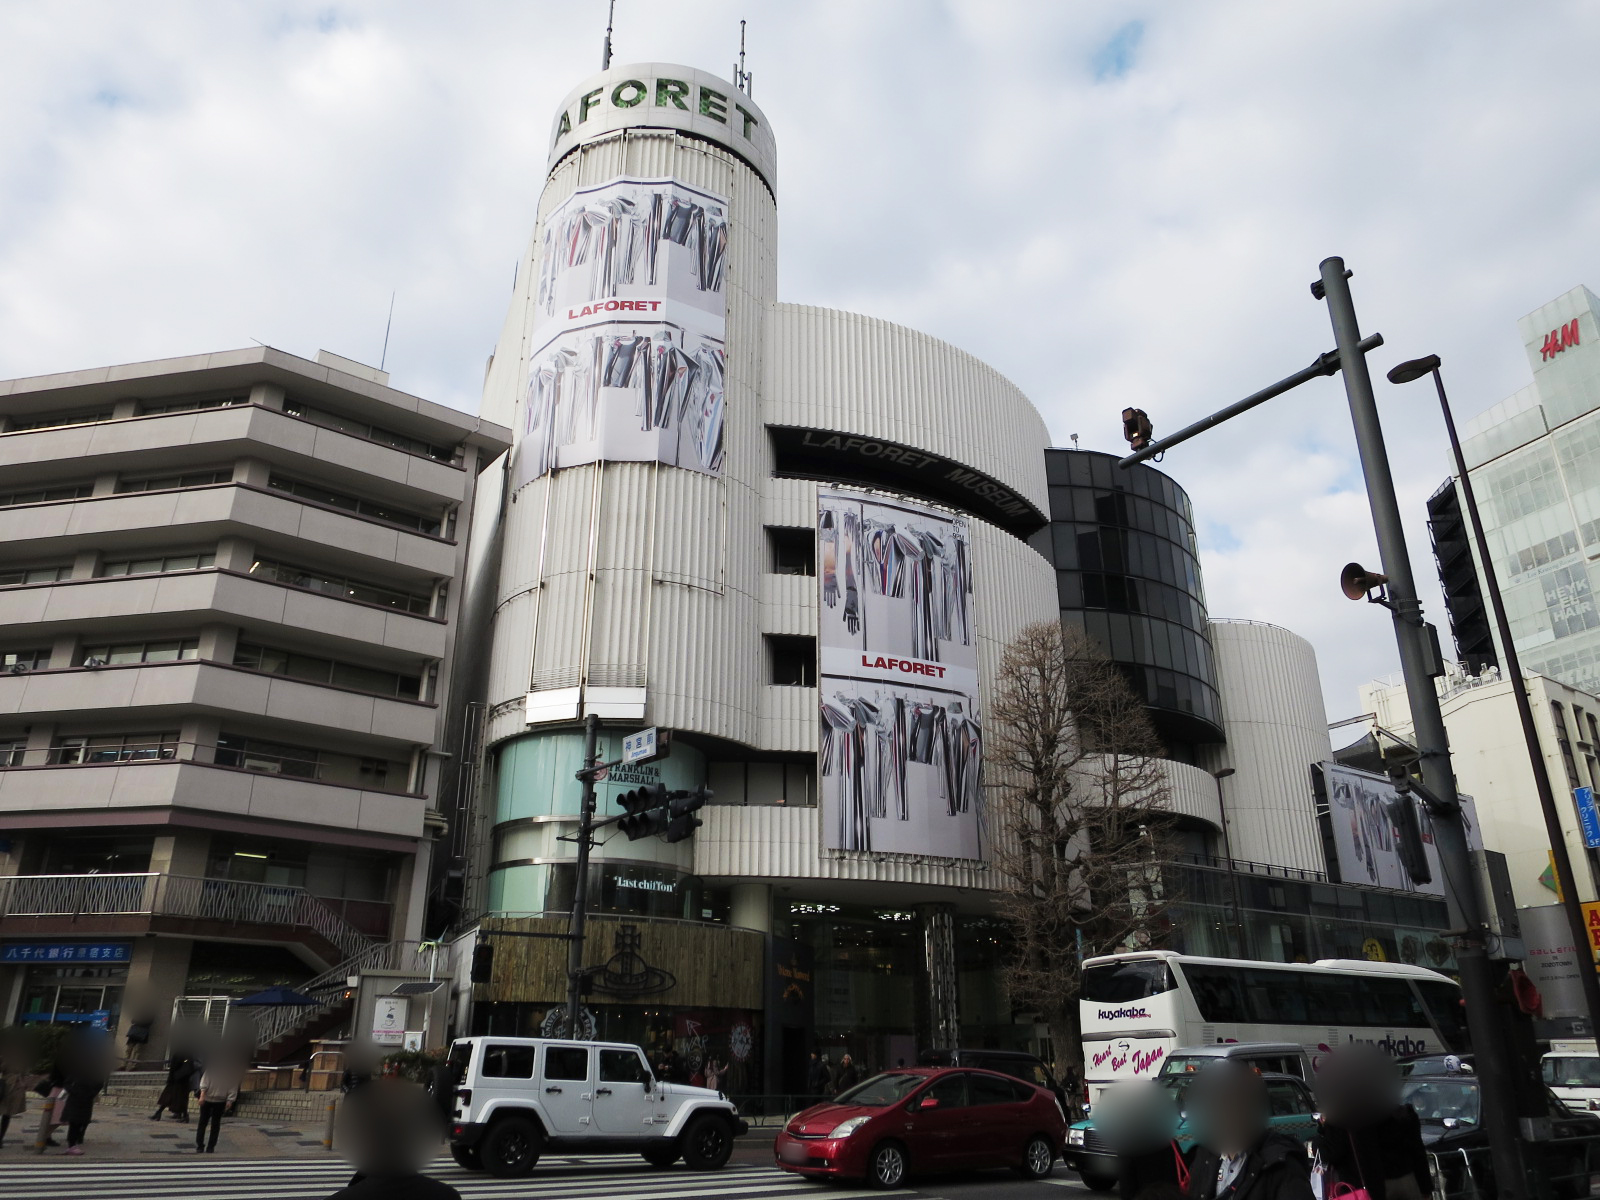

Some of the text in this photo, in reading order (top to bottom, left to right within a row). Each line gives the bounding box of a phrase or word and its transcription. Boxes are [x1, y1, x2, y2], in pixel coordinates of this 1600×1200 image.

[568, 300, 662, 320] LAFORET
[1540, 318, 1580, 362] H&M
[802, 431, 1031, 518] LAFORET MUSEUM
[1553, 601, 1592, 622] HAIR
[862, 655, 947, 679] LAFORET
[625, 733, 654, 752] 神宮前
[6, 947, 125, 959] 八千代銀行原宿支店
[1098, 1007, 1146, 1020] kusakabe
[1093, 1044, 1112, 1067] Heart
[1112, 1046, 1163, 1075] Beat Japan
